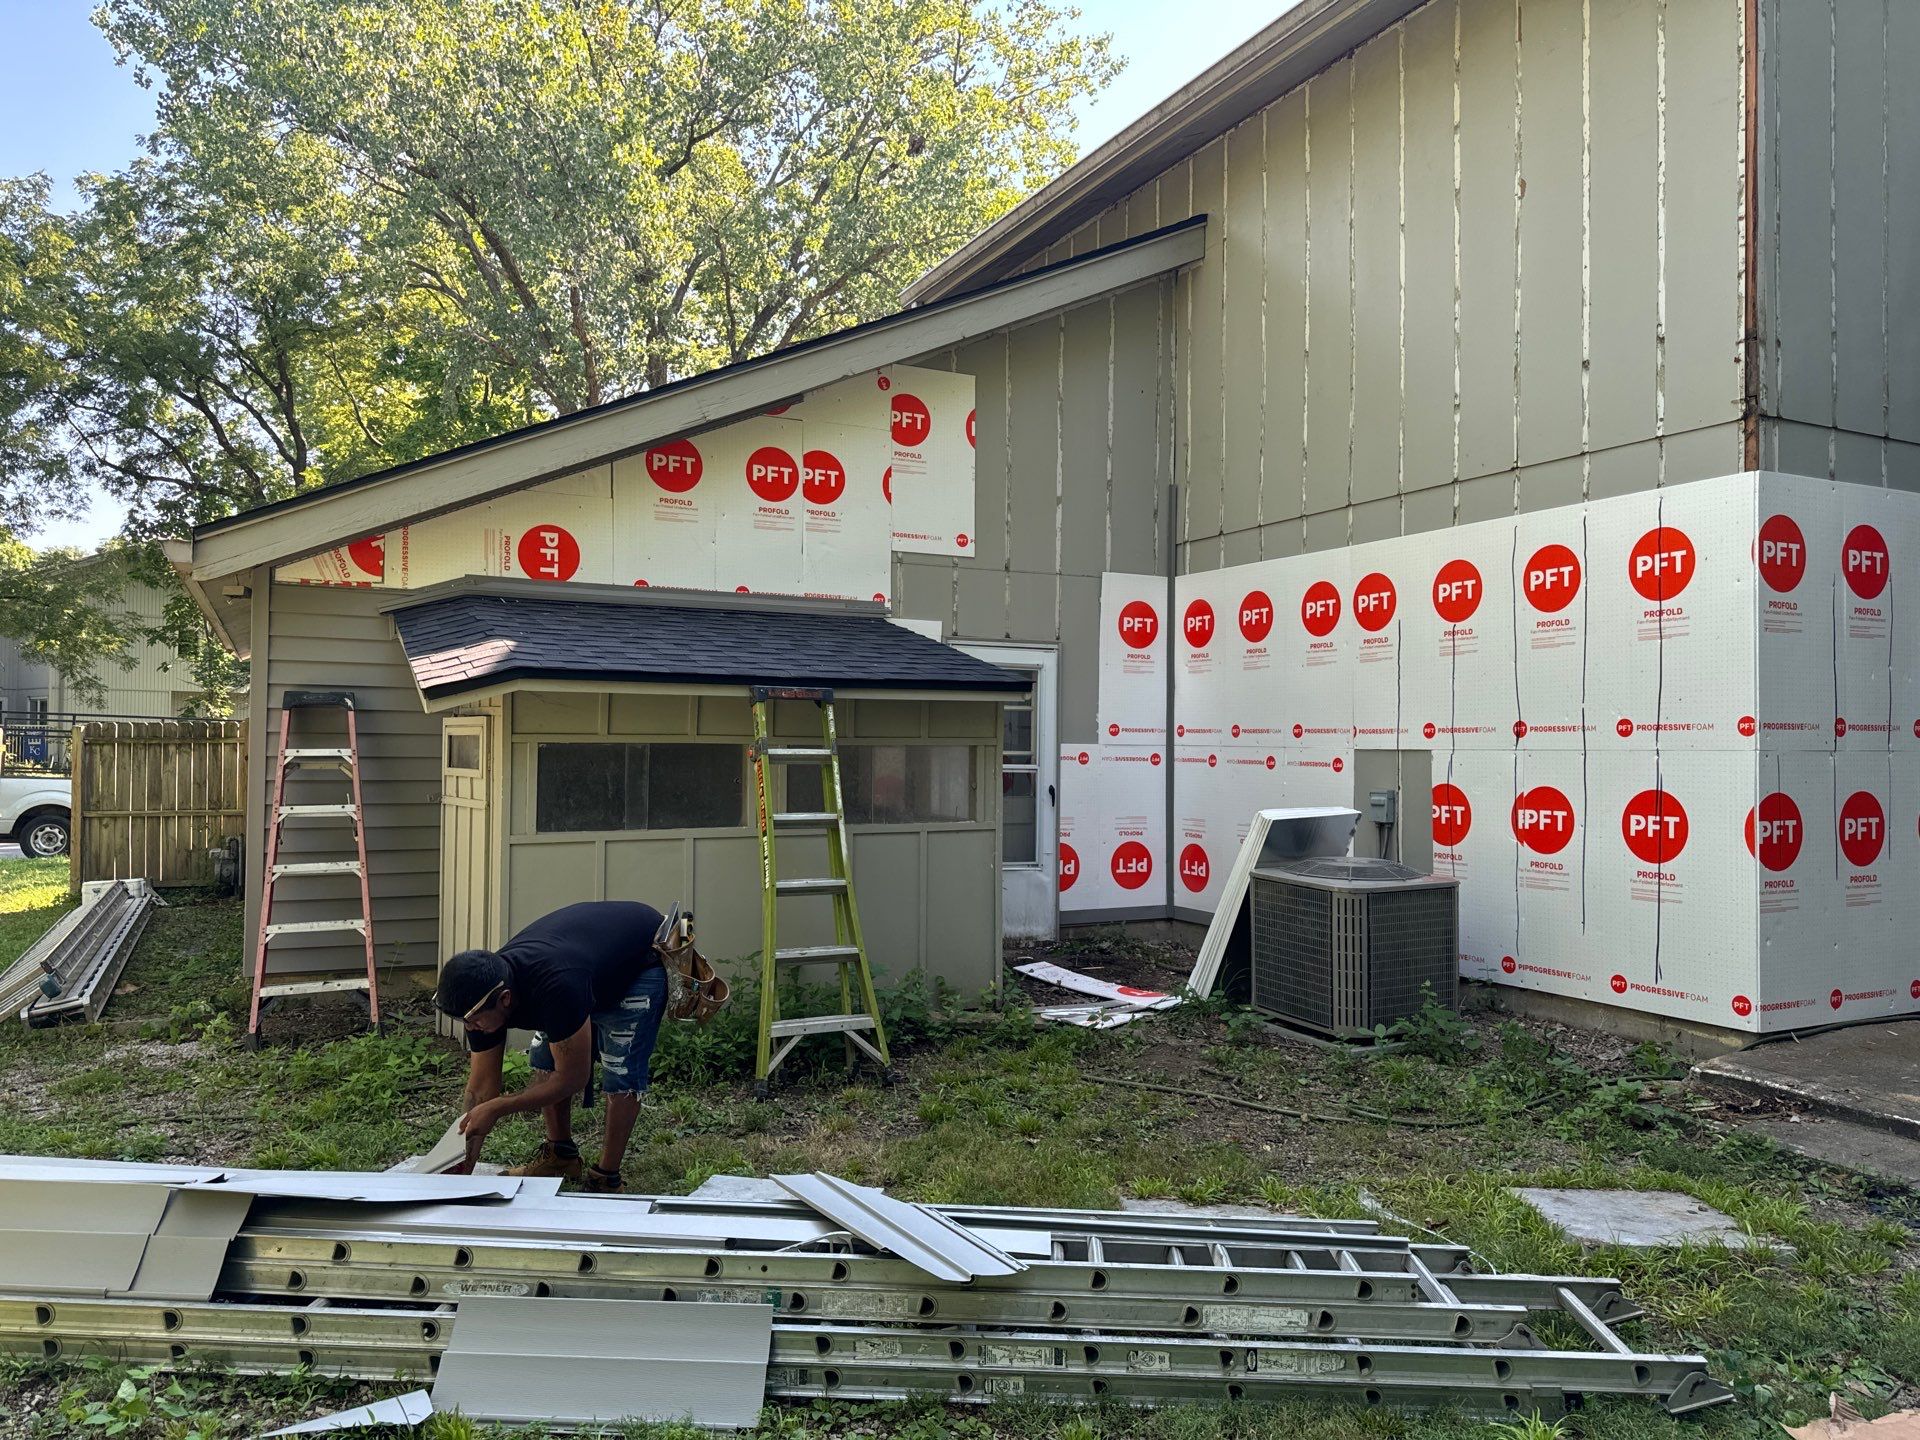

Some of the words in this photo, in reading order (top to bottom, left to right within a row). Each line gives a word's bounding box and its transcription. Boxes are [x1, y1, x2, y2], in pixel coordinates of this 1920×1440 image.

[891, 410, 925, 430] PFT
[894, 451, 922, 460] PROFOLD
[652, 453, 695, 474] PFT
[752, 464, 792, 484] PFT
[803, 467, 839, 487] PFT
[659, 497, 693, 507] PROFOLD
[758, 506, 789, 515] PROFOLD
[540, 531, 558, 578] PFT
[1763, 540, 1800, 567] PFT
[1636, 549, 1687, 579] PFT
[1849, 549, 1884, 574] PFT
[1530, 565, 1574, 591] PFT
[1438, 579, 1476, 603] PFT
[1306, 599, 1336, 619] PFT
[1358, 591, 1391, 613] PFT
[1768, 601, 1797, 611] PROFOLD
[1242, 607, 1269, 626] PFT
[1644, 608, 1683, 618] PROFOLD
[1854, 607, 1881, 616] PROFOLD
[1123, 617, 1153, 633] PFT
[1187, 615, 1211, 632] PFT
[1536, 619, 1570, 629] PROFOLD
[1443, 628, 1473, 637] PROFOLD
[1363, 636, 1389, 645] PROFOLD
[1636, 723, 1714, 731] PROGRESSIVEFOAM
[1763, 722, 1820, 730] PROGRESSIVEFOAM
[1629, 814, 1680, 839] PFT
[1759, 819, 1797, 844] PFT
[1844, 817, 1880, 841] PFT
[1434, 852, 1463, 861] PROFOLD
[1116, 858, 1148, 873] PFT
[1183, 859, 1206, 877] PFT
[1530, 861, 1564, 870] PROFOLD
[1637, 870, 1676, 881] PROFOLD
[1850, 874, 1877, 883] PROFOLD
[1764, 880, 1795, 889] PROFOLD
[1503, 961, 1514, 969] PFT
[1630, 982, 1709, 1003] PROGRESSIVEFOAM
[1844, 988, 1897, 1001] PROGRESSIVEFOAM
[1733, 1001, 1749, 1010] PFT
